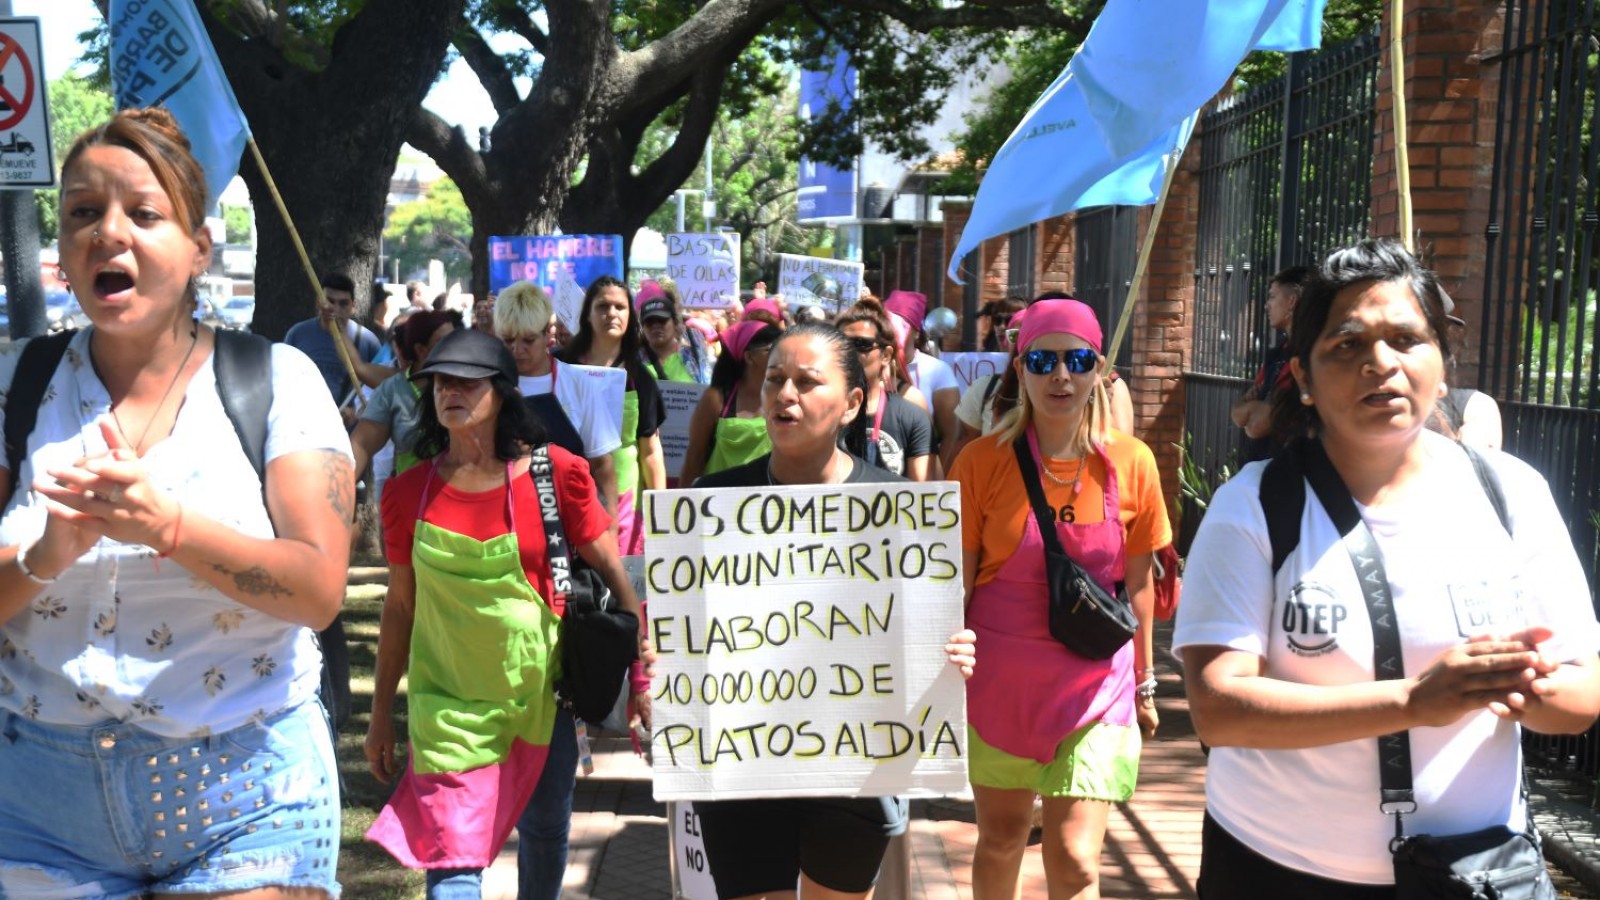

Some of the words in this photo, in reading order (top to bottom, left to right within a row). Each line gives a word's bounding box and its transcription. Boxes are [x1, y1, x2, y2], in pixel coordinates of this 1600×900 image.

[492, 241, 519, 260] EL
[526, 238, 614, 259] HAMBRE
[669, 235, 733, 257] BASTA
[511, 261, 538, 280] NO
[546, 261, 577, 280] SE
[669, 264, 688, 279] DE
[650, 492, 725, 537] LOS
[736, 489, 959, 535] COMEDORES
[551, 557, 572, 595] FAS
[653, 592, 895, 655] ELABORAN
[1282, 600, 1348, 634] UTEP
[829, 663, 894, 698] DE
[653, 720, 826, 767] PLATOS
[684, 810, 700, 838] EL
[685, 845, 704, 873] NO
